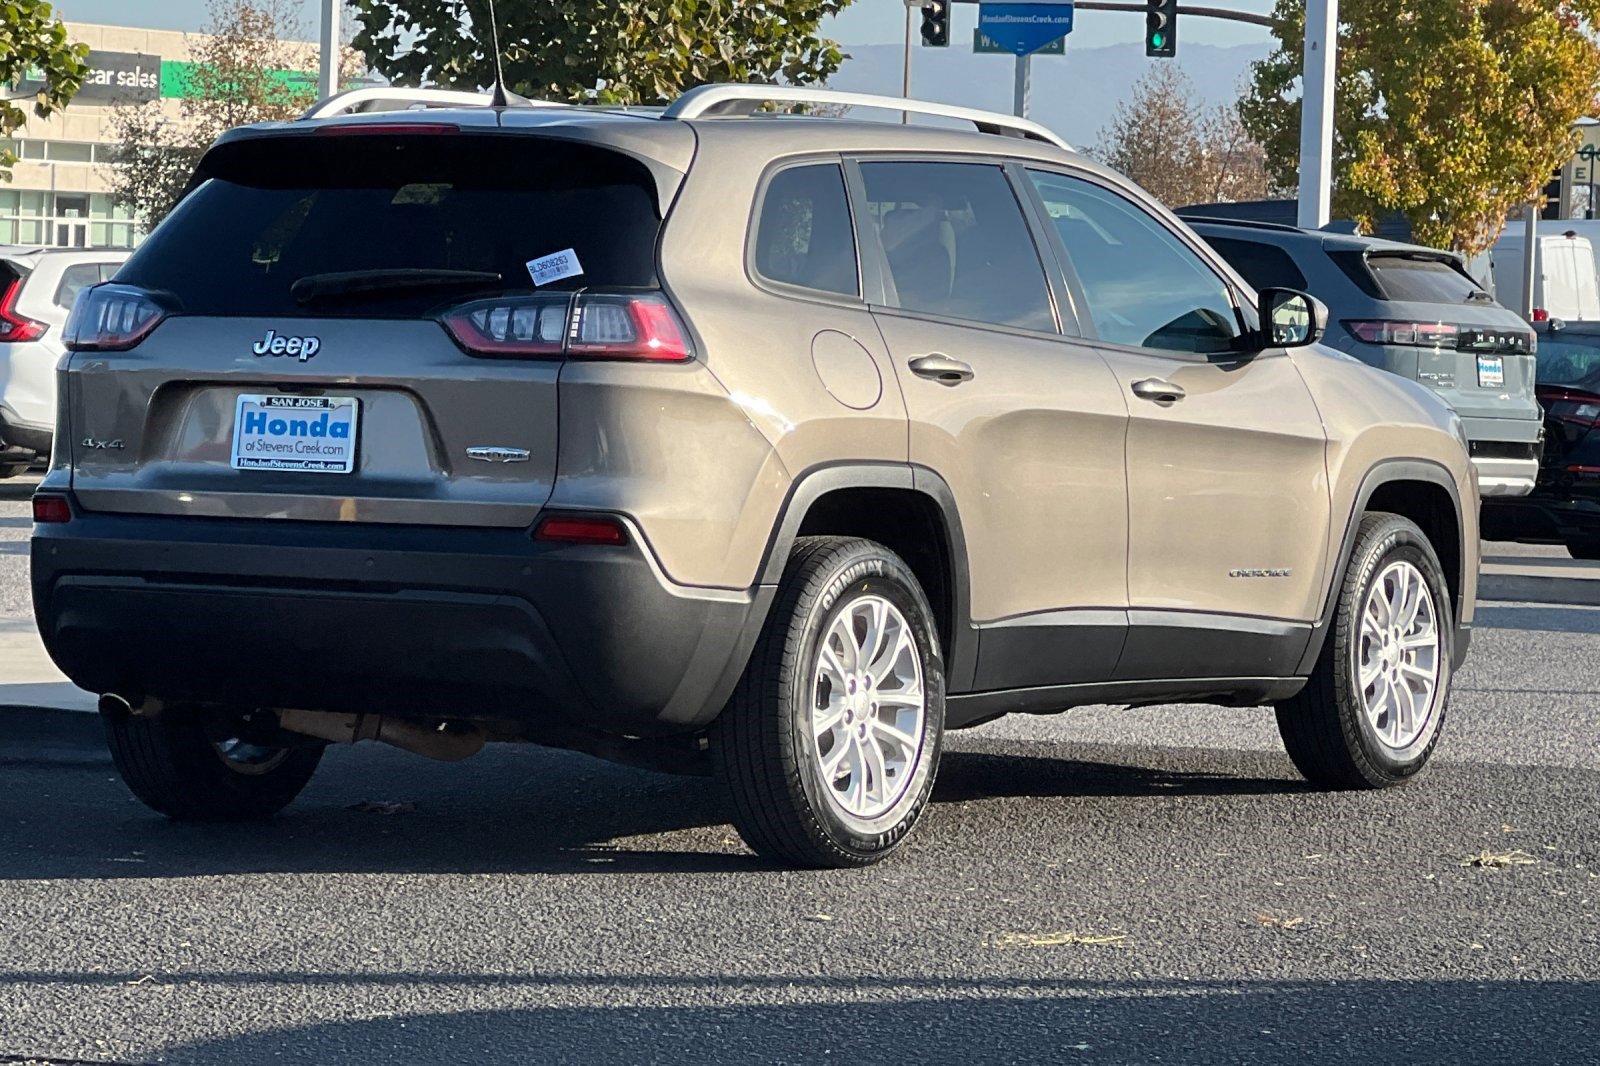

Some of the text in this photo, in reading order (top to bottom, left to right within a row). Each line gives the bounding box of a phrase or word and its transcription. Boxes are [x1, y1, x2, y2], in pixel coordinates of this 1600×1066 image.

[85, 66, 158, 88] car sales
[252, 329, 321, 362] Jeep
[1477, 333, 1523, 346] Honda
[271, 397, 324, 408] SAN JOSE
[244, 411, 350, 439] Honda
[245, 439, 344, 455] of Stevens Creek.com
